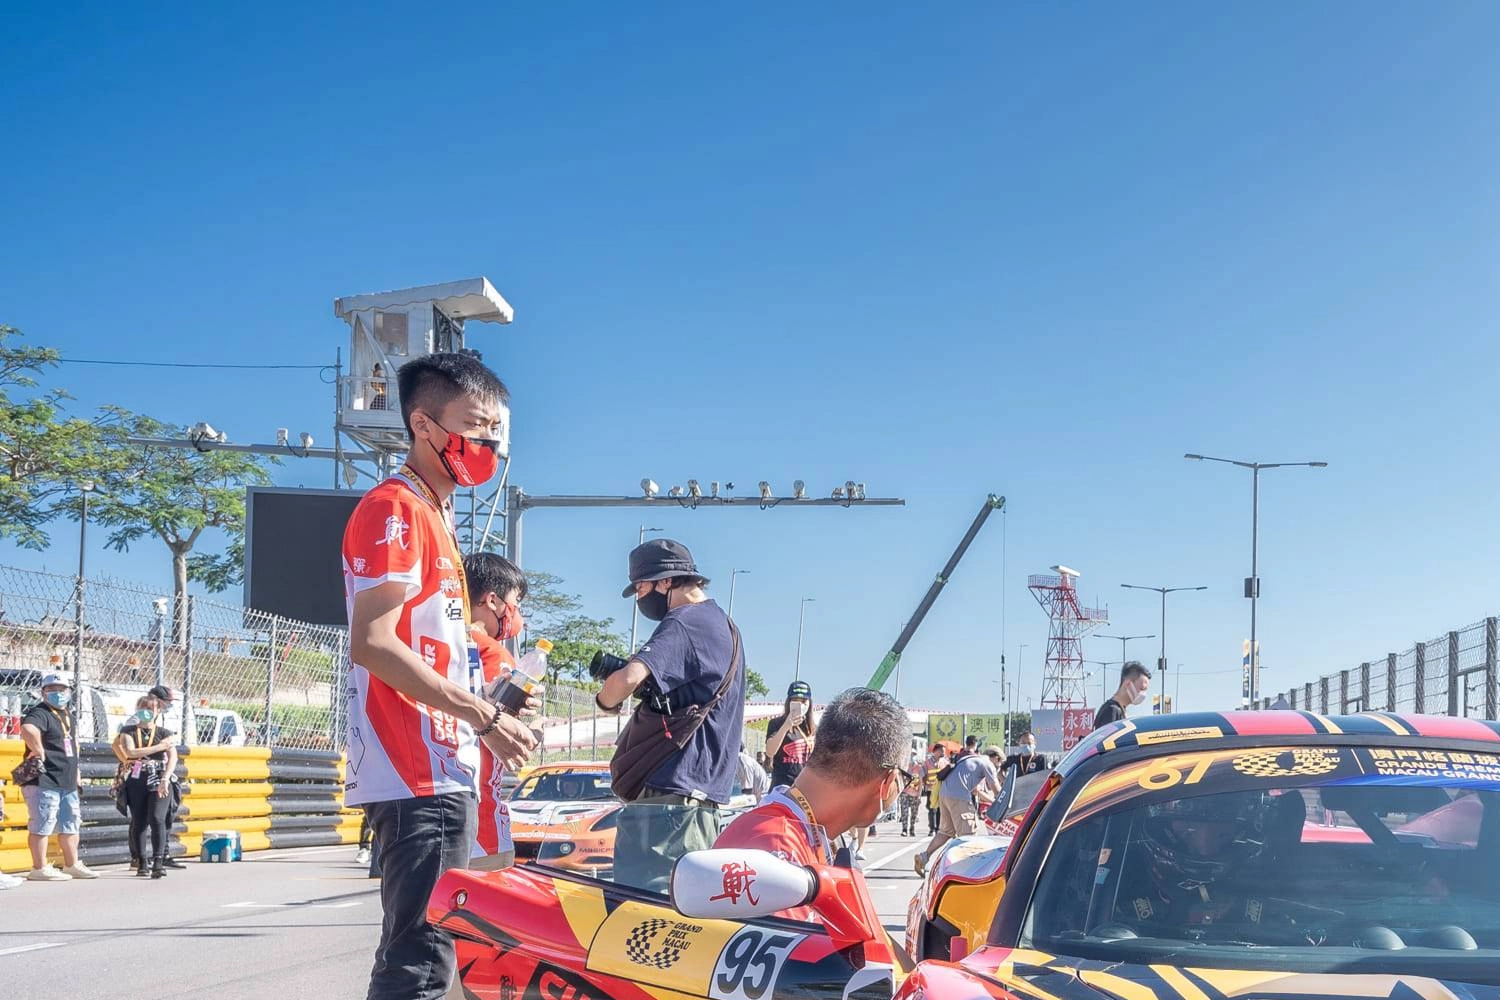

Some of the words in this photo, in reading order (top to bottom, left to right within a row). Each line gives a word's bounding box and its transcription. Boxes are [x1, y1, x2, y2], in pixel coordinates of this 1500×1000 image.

[1065, 712, 1093, 730] 永利
[1375, 760, 1449, 770] GRANDE
[1378, 768, 1438, 777] MACAU
[674, 922, 703, 933] GRAND
[668, 930, 687, 939] PRIX
[662, 937, 691, 950] MACAU
[717, 930, 796, 1000] 95
